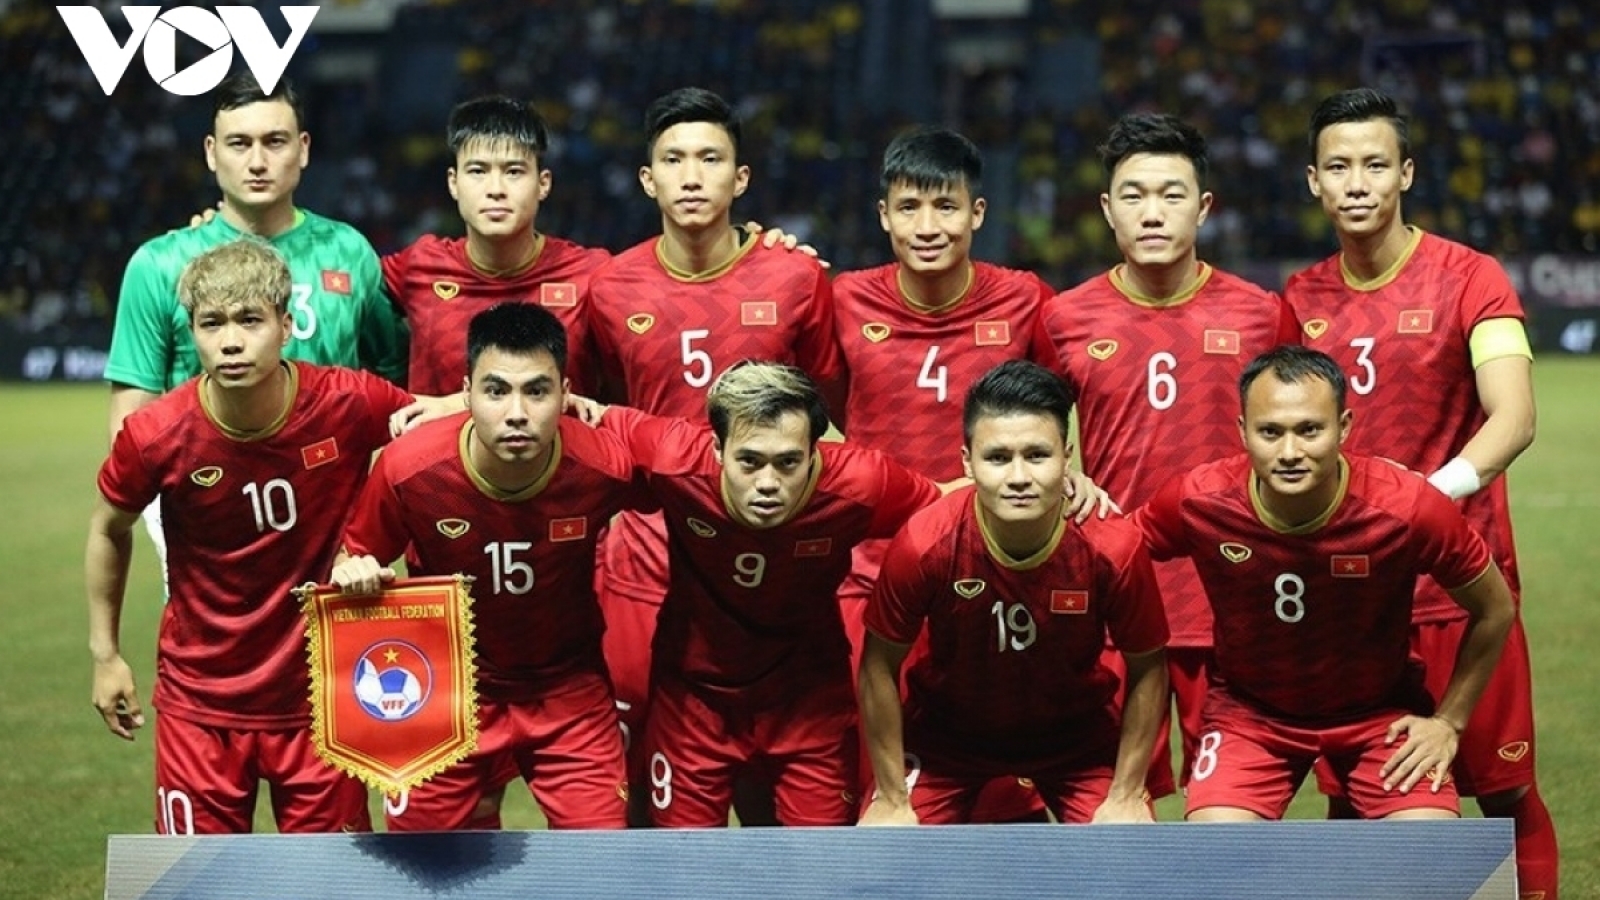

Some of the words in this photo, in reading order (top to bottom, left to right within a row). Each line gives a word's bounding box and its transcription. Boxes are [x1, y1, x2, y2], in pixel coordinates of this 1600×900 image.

[680, 329, 713, 388] 5
[916, 345, 948, 403] 4
[1147, 351, 1177, 410] 6
[1350, 337, 1376, 395] 3
[242, 478, 297, 533] 10
[484, 541, 534, 595] 15
[732, 553, 765, 588] 9
[1274, 573, 1304, 623] 8
[991, 601, 1037, 652] 19
[381, 699, 405, 711] VFF
[651, 751, 672, 810] 9
[1193, 731, 1222, 781] 8
[158, 786, 194, 835] 10
